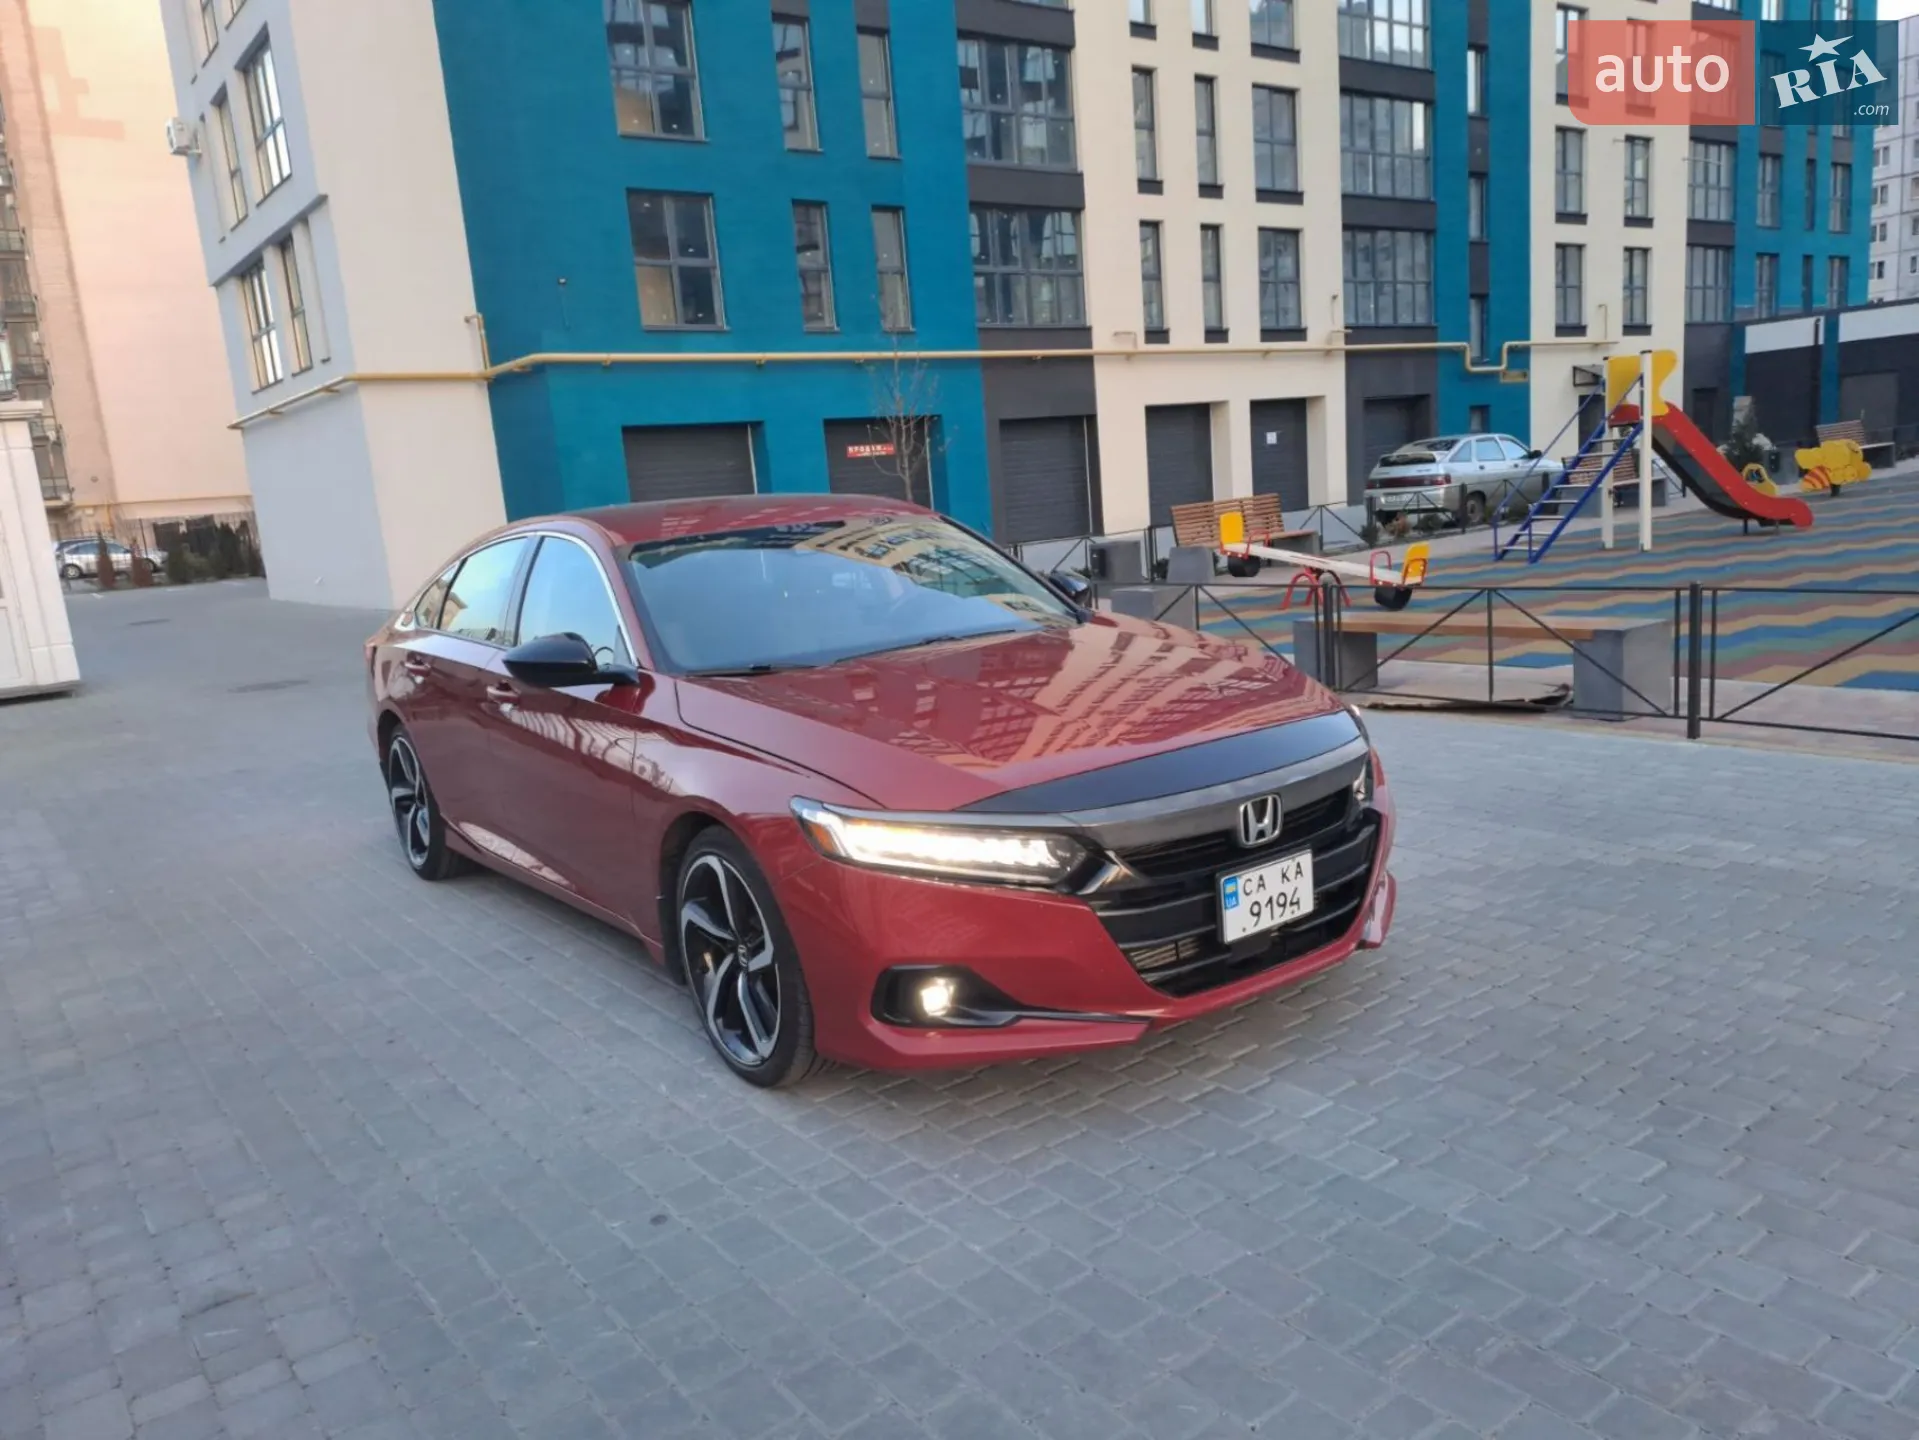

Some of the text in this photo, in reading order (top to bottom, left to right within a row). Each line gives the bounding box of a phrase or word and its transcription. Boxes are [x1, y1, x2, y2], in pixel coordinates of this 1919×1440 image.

[1243, 861, 1304, 896] CA KA
[1249, 887, 1301, 927] 9194
